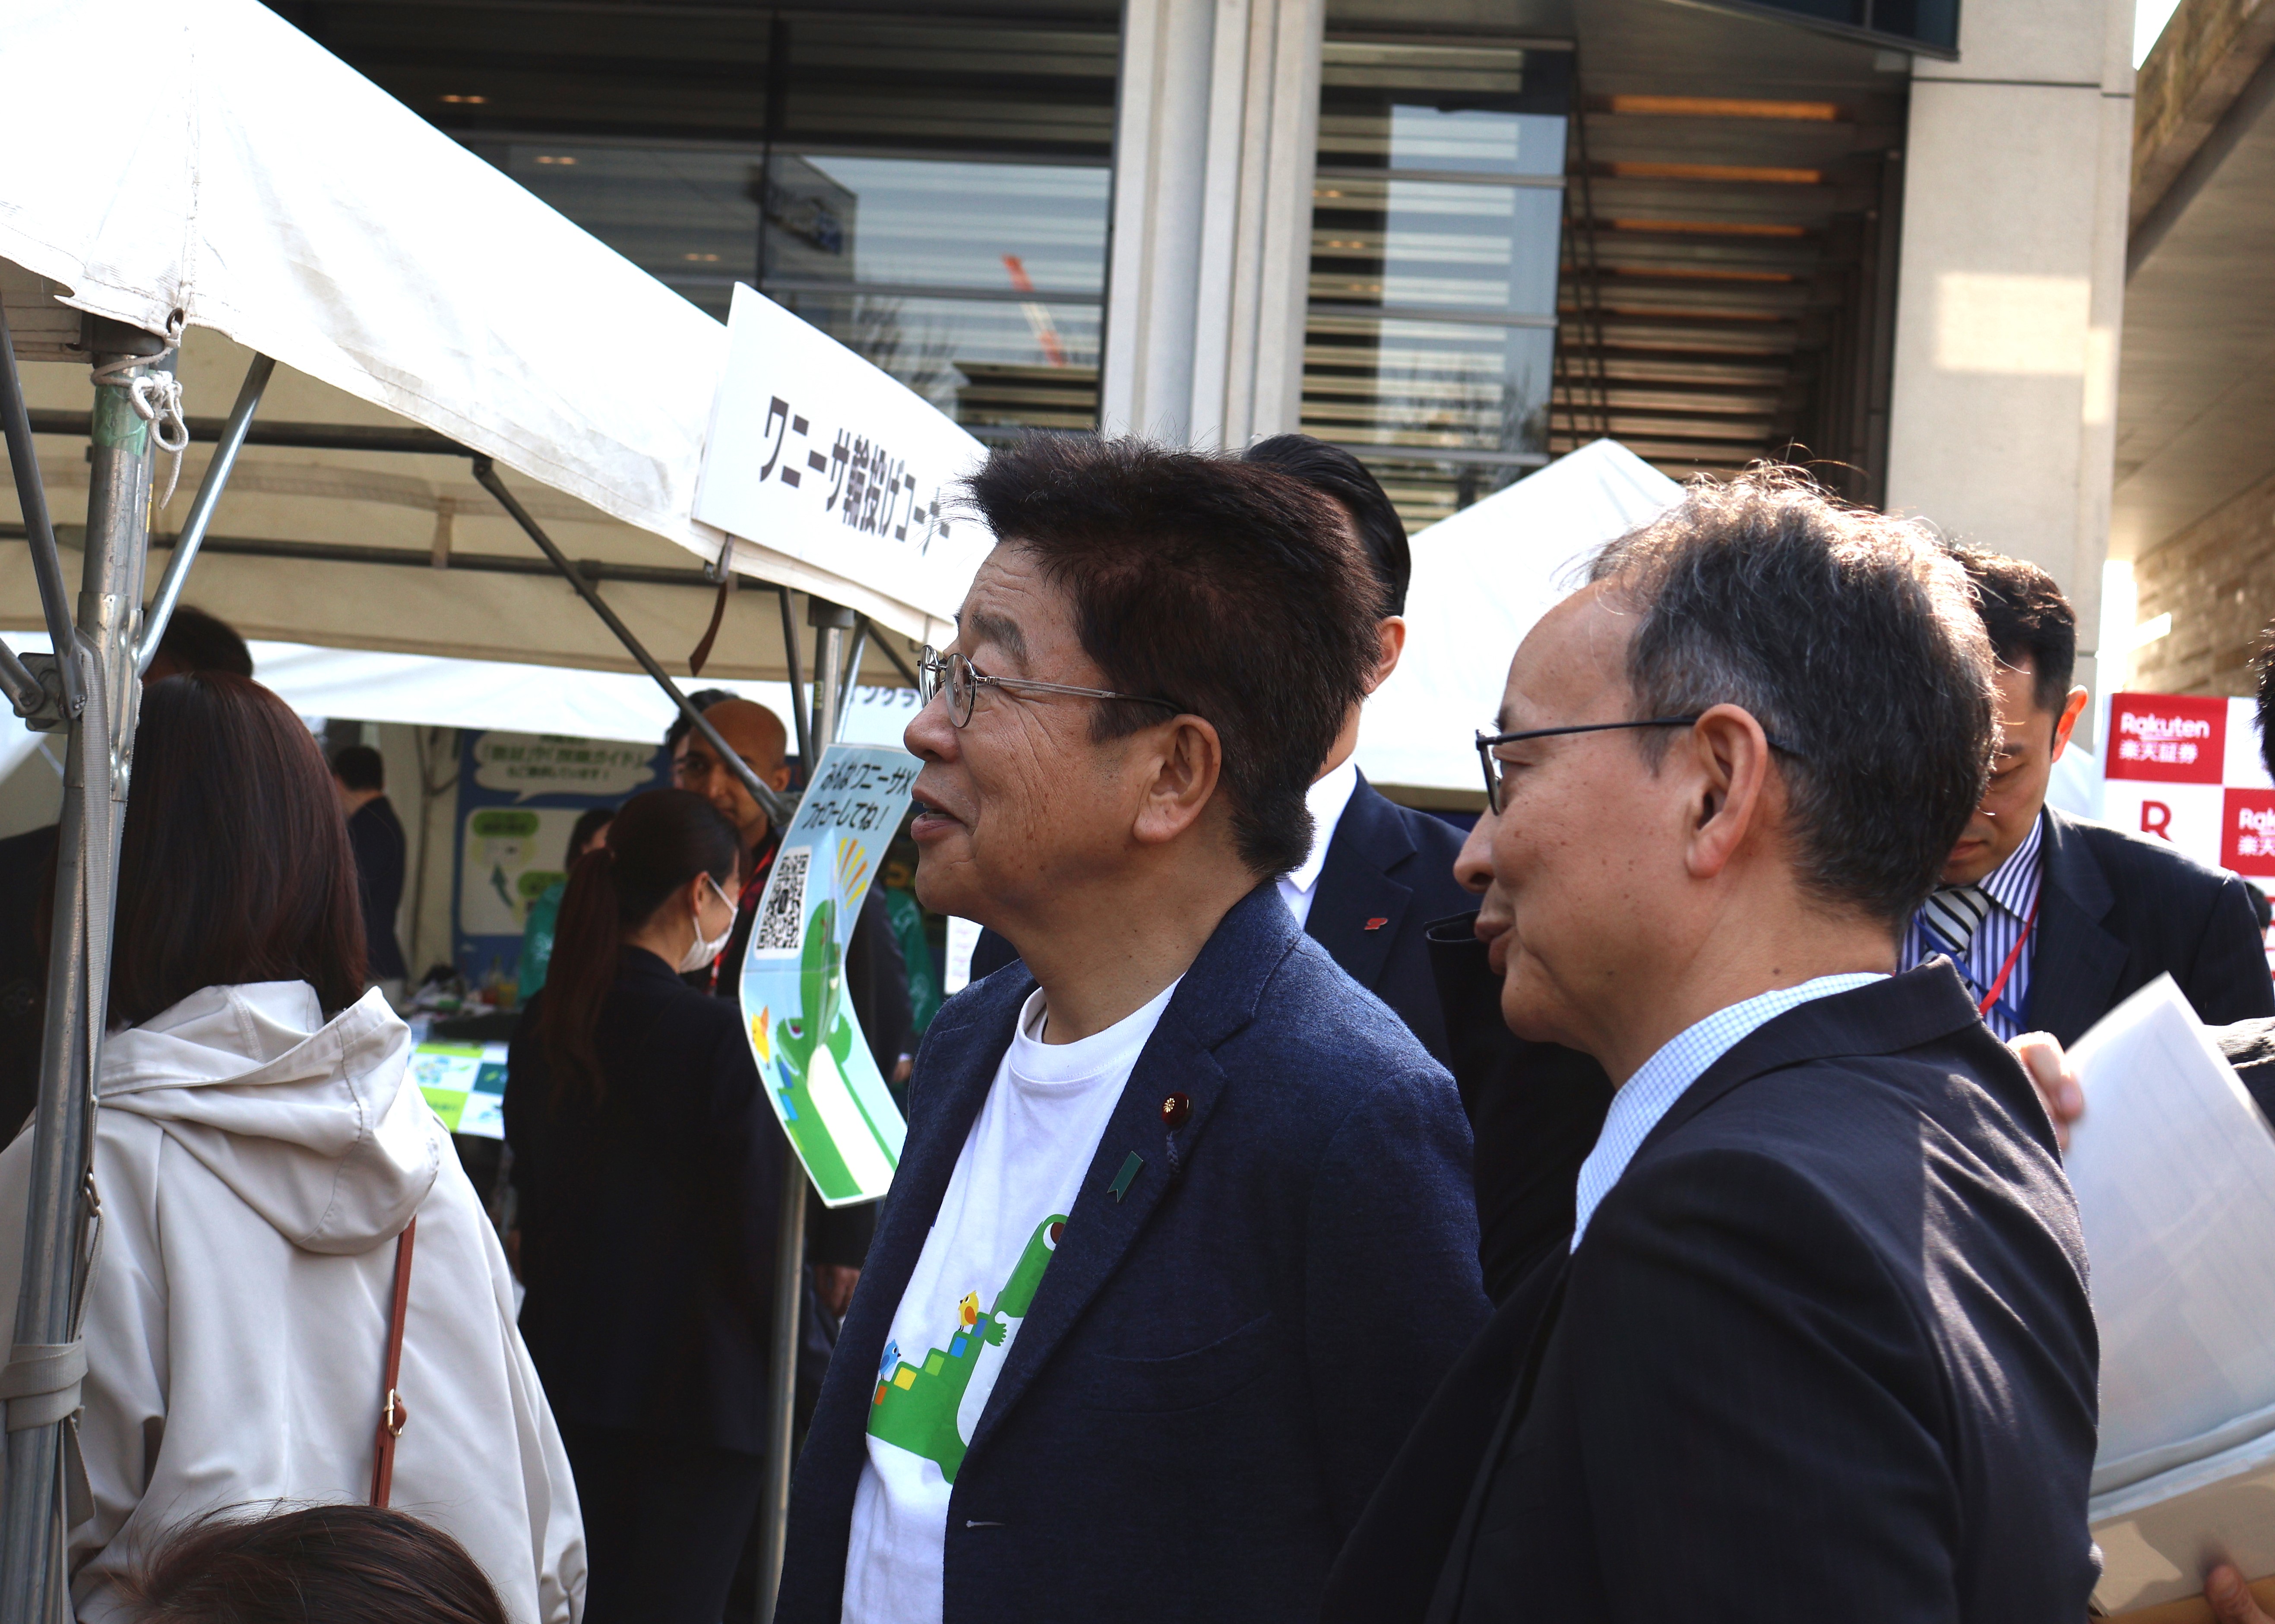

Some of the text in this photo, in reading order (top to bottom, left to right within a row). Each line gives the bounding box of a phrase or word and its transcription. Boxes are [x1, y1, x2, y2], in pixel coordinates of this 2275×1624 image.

[759, 395, 951, 557] ワニーサ輪投げコーナー
[2120, 712, 2210, 739] Rakuten
[2141, 800, 2175, 843] R
